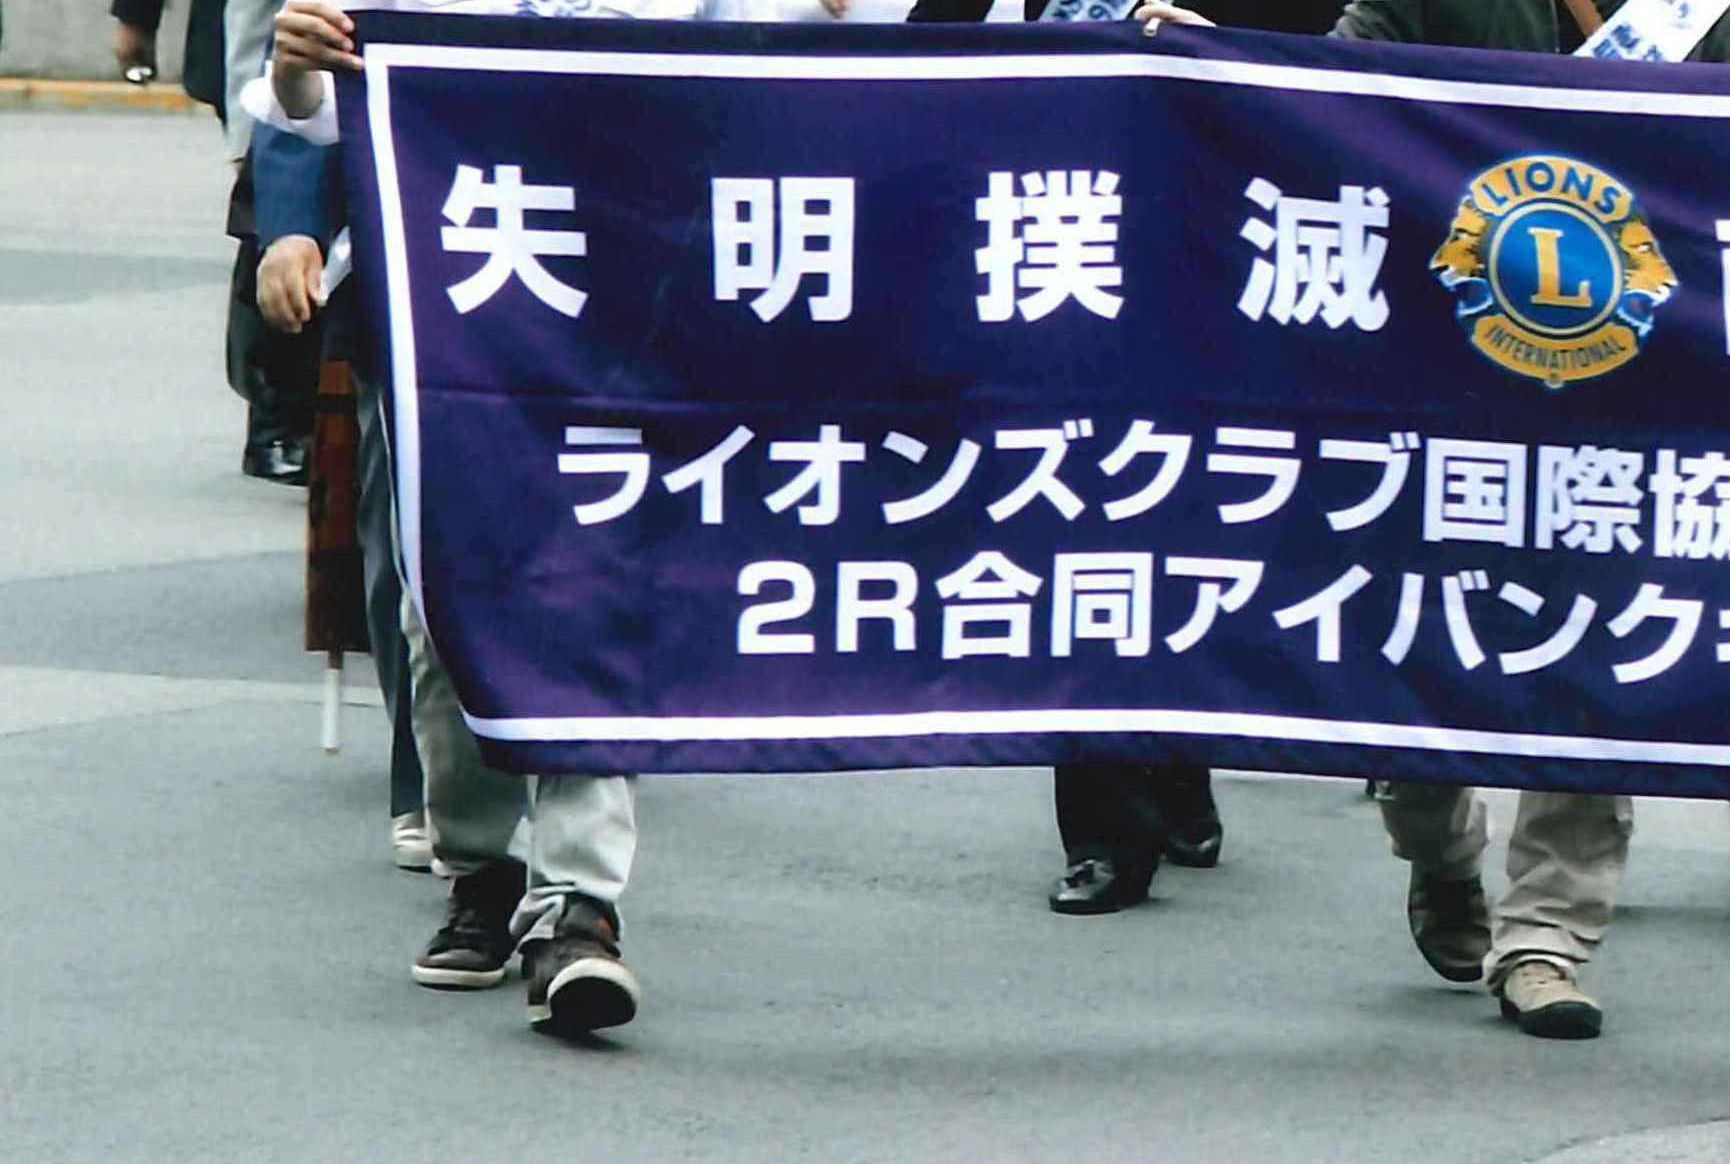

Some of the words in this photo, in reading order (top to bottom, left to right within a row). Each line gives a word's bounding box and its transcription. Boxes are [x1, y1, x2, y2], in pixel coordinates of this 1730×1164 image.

[1481, 161, 1621, 215] LIONS
[440, 164, 1389, 331] 失明撲滅
[1527, 227, 1593, 309] L
[1487, 323, 1628, 369] INTERNATIONAL
